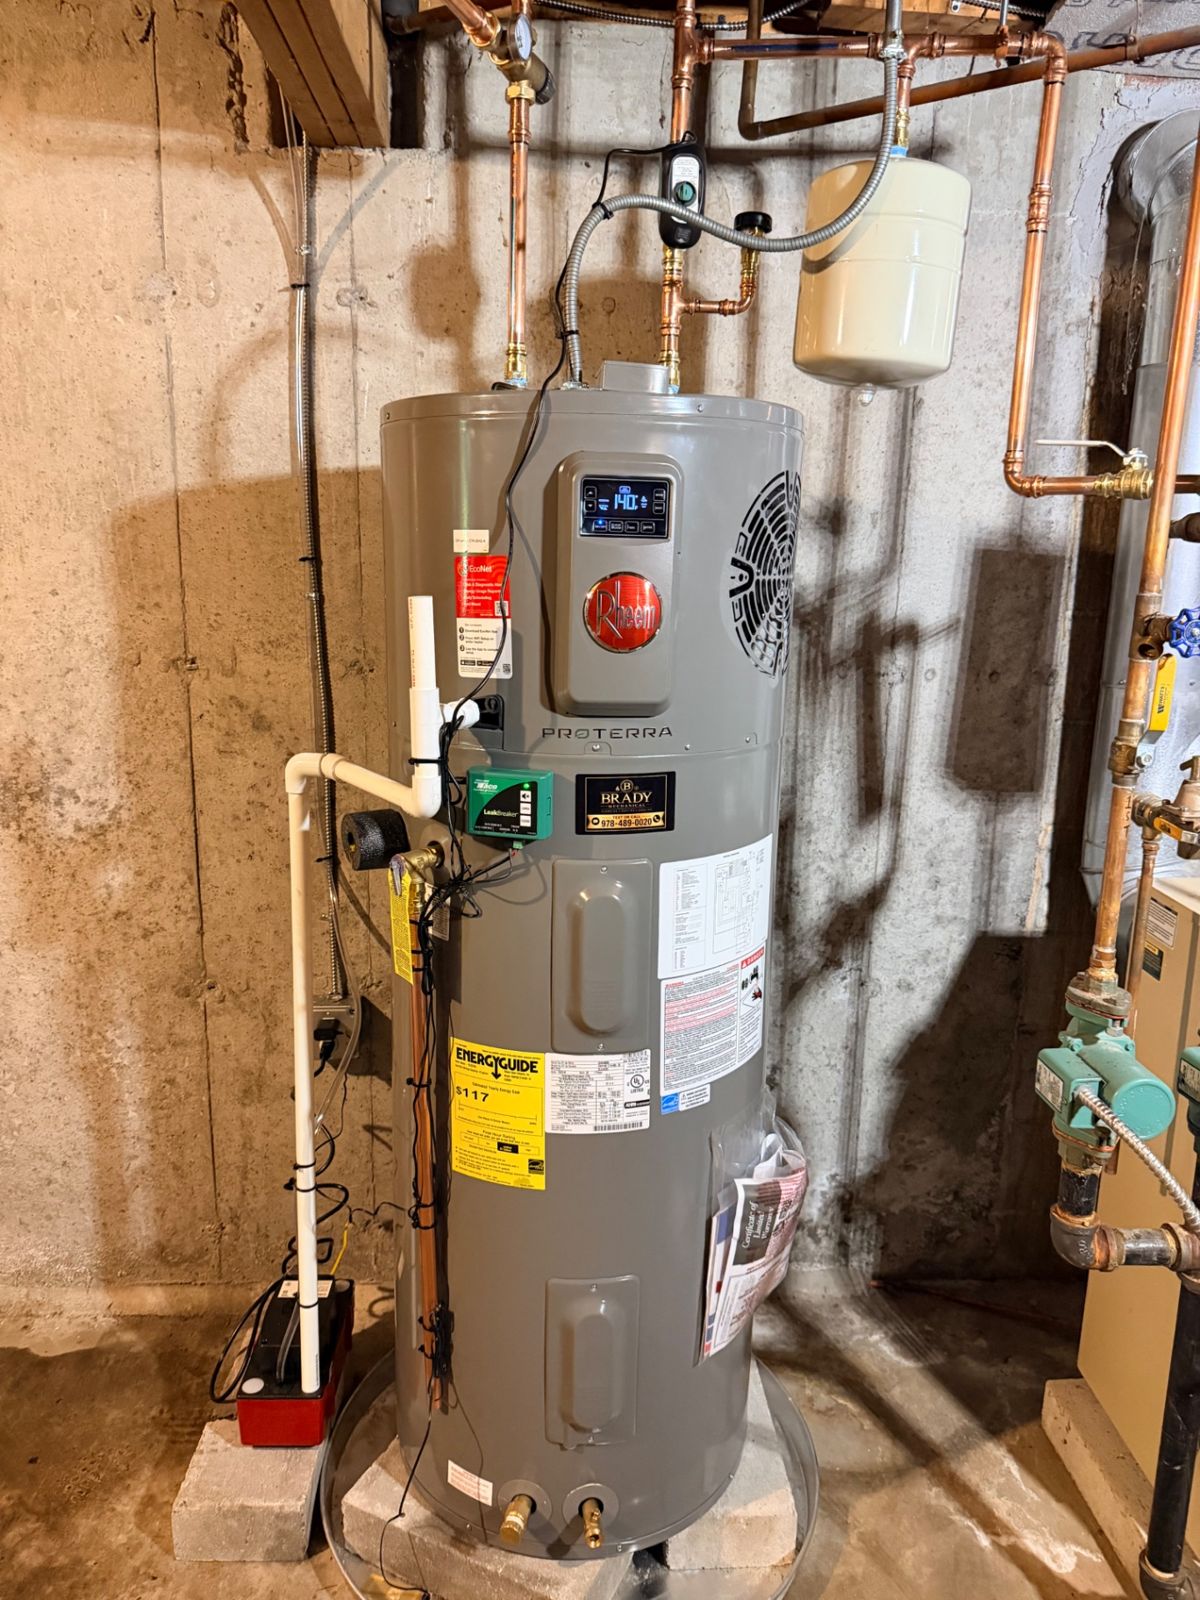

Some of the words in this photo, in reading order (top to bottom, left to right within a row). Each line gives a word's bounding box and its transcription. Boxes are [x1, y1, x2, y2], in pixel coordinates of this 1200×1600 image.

[614, 493, 636, 510] 140
[469, 564, 493, 573] EcoNet
[596, 579, 656, 640] Rheem
[542, 727, 673, 739] PROTERRA
[623, 782, 631, 791] B
[601, 791, 653, 804] BRADY
[601, 818, 652, 828] 978-489-0020
[456, 1047, 538, 1074] ENERGYGUIDE
[456, 1086, 489, 1102] $117
[742, 1212, 755, 1248] Certificate
[749, 1200, 759, 1211] of
[753, 1211, 764, 1238] Limited
[761, 1206, 775, 1240] Warranty
